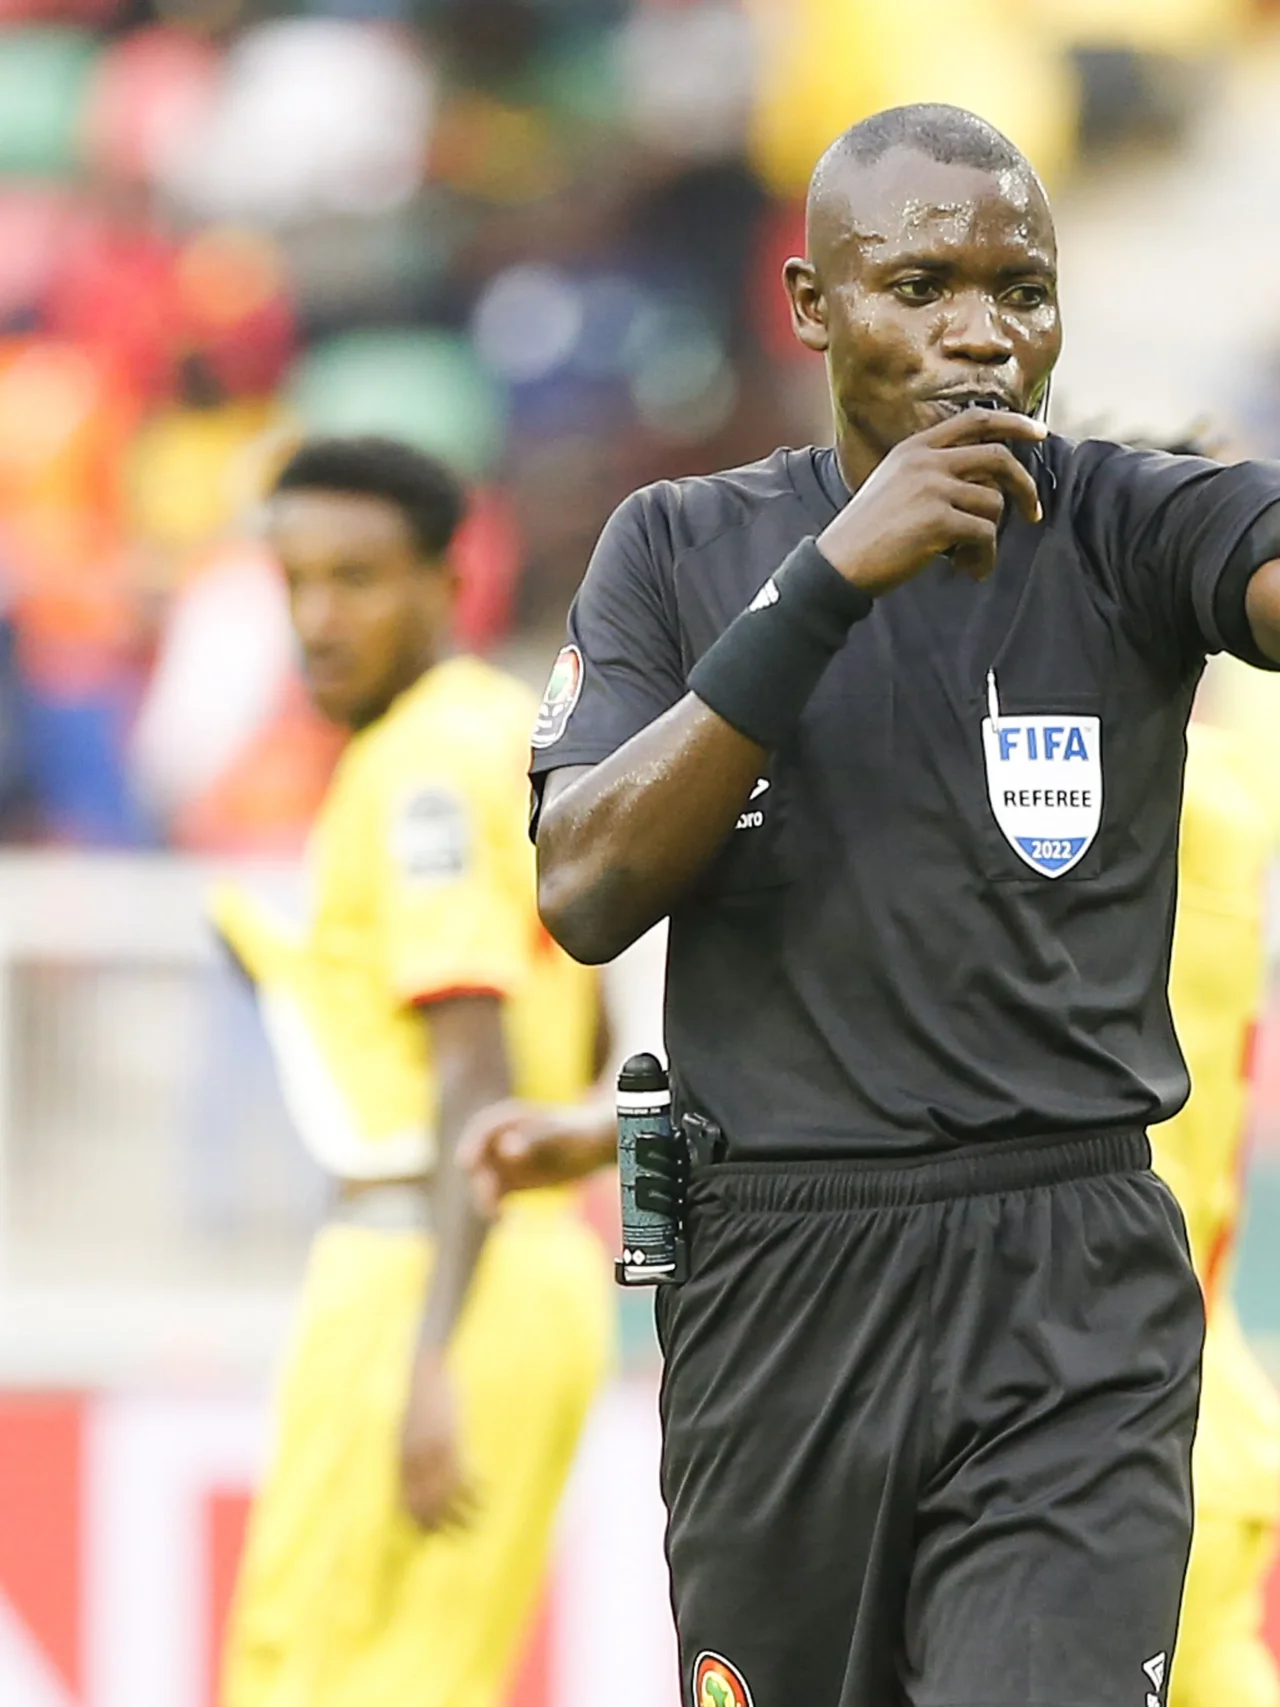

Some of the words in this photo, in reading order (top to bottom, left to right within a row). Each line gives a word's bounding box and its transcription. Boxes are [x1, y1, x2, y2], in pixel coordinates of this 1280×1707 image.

[999, 727, 1089, 761] FIFA
[1003, 789, 1092, 808] REFEREE
[1031, 841, 1073, 859] 2022
